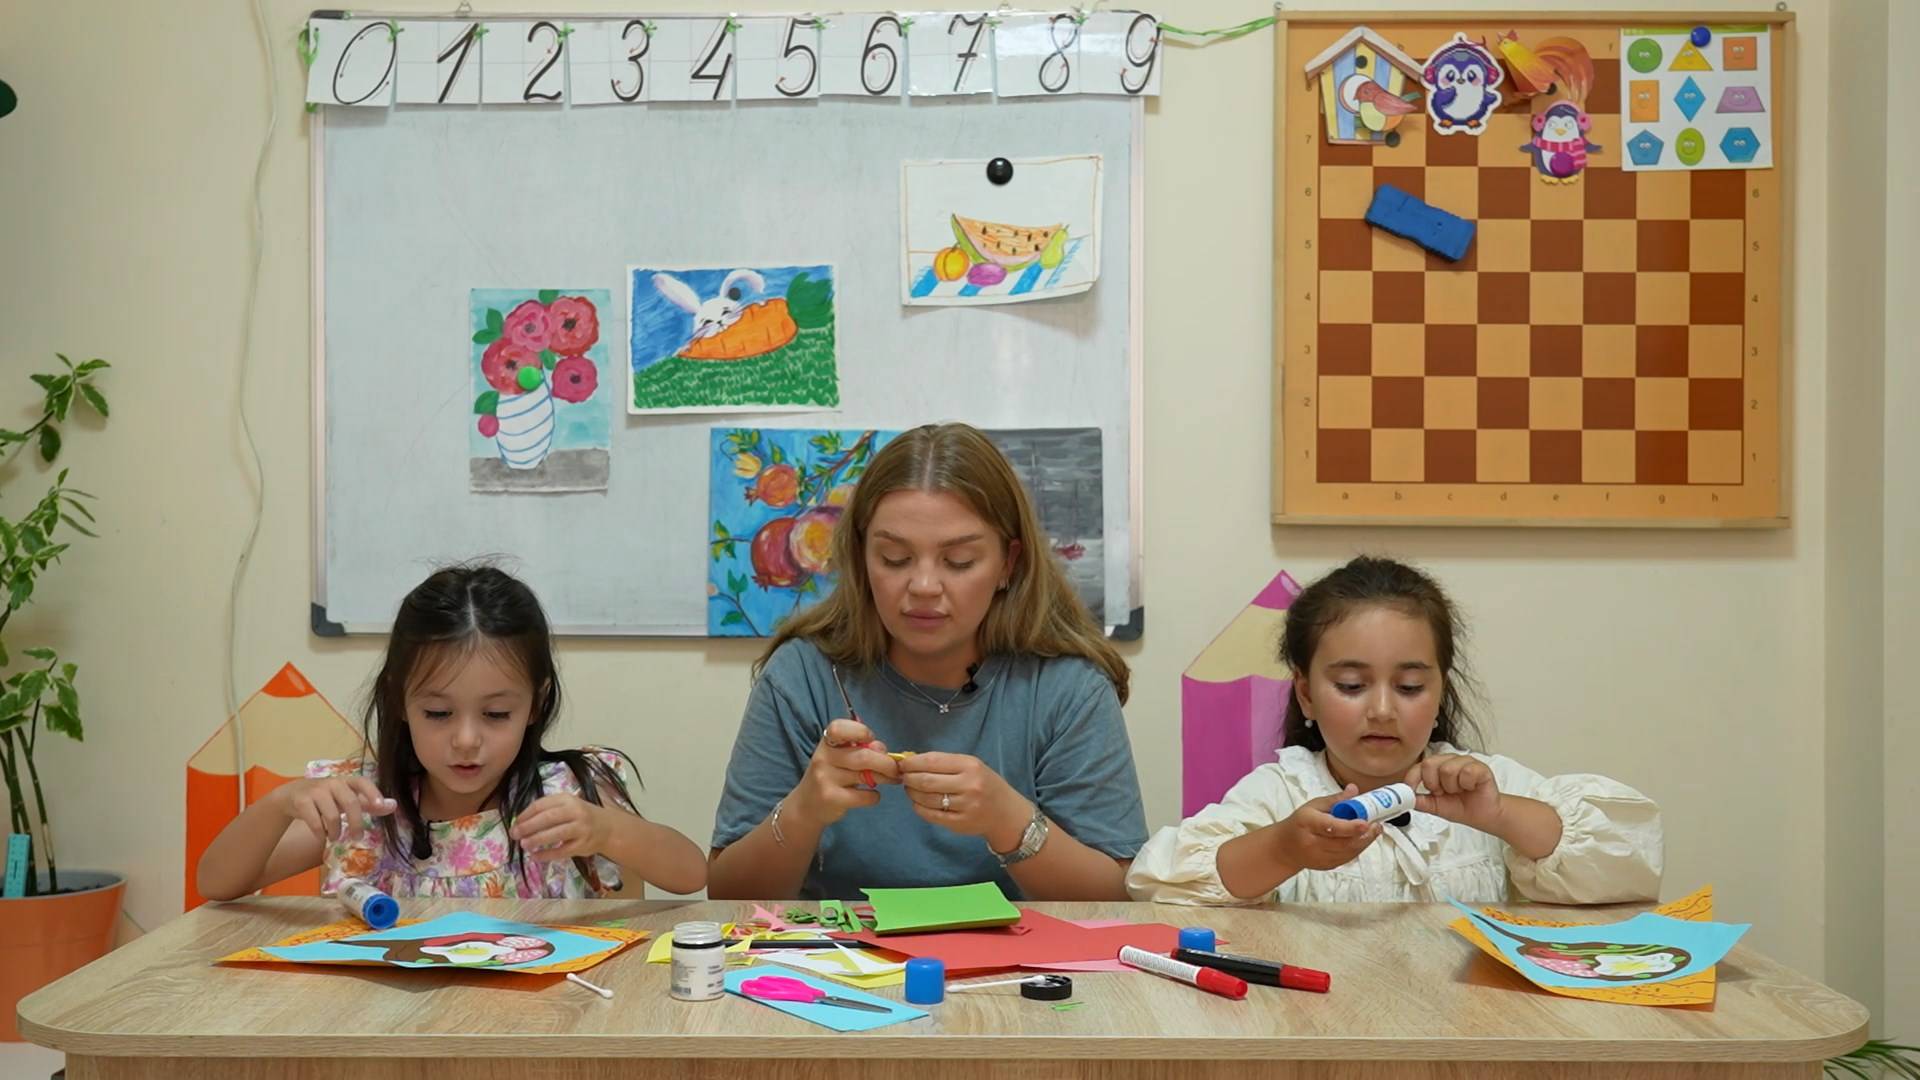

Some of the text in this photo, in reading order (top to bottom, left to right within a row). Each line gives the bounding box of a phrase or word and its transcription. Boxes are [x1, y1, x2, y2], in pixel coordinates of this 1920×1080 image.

[333, 13, 1161, 105] 0 1 2 3 4 5 6 7 8 9
